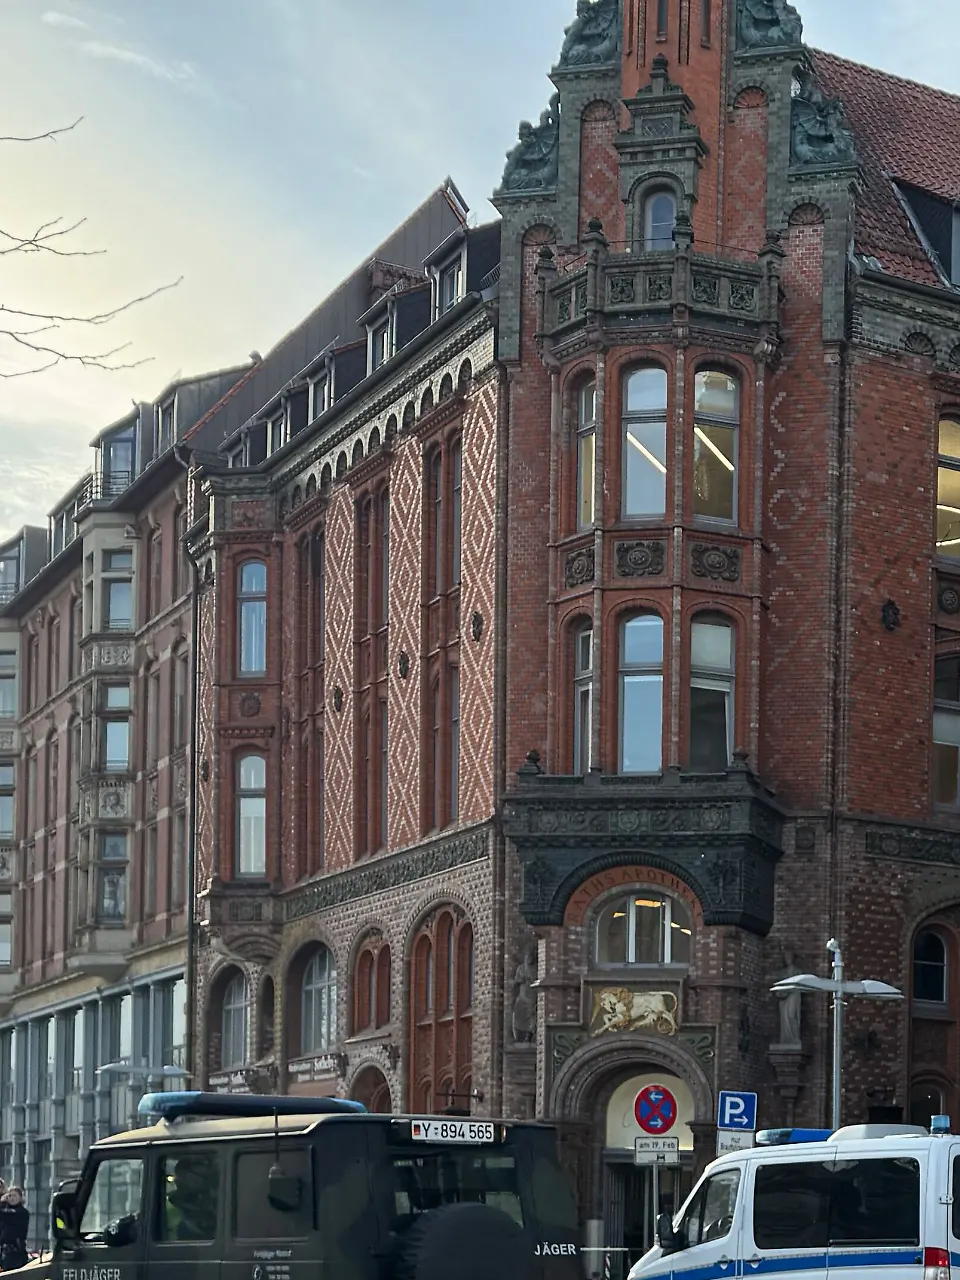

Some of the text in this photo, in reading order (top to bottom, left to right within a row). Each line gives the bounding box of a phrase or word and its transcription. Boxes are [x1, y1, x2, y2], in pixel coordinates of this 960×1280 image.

[724, 1096, 746, 1125] P
[468, 1124, 493, 1140] 565
[533, 1241, 577, 1256] JÄGER
